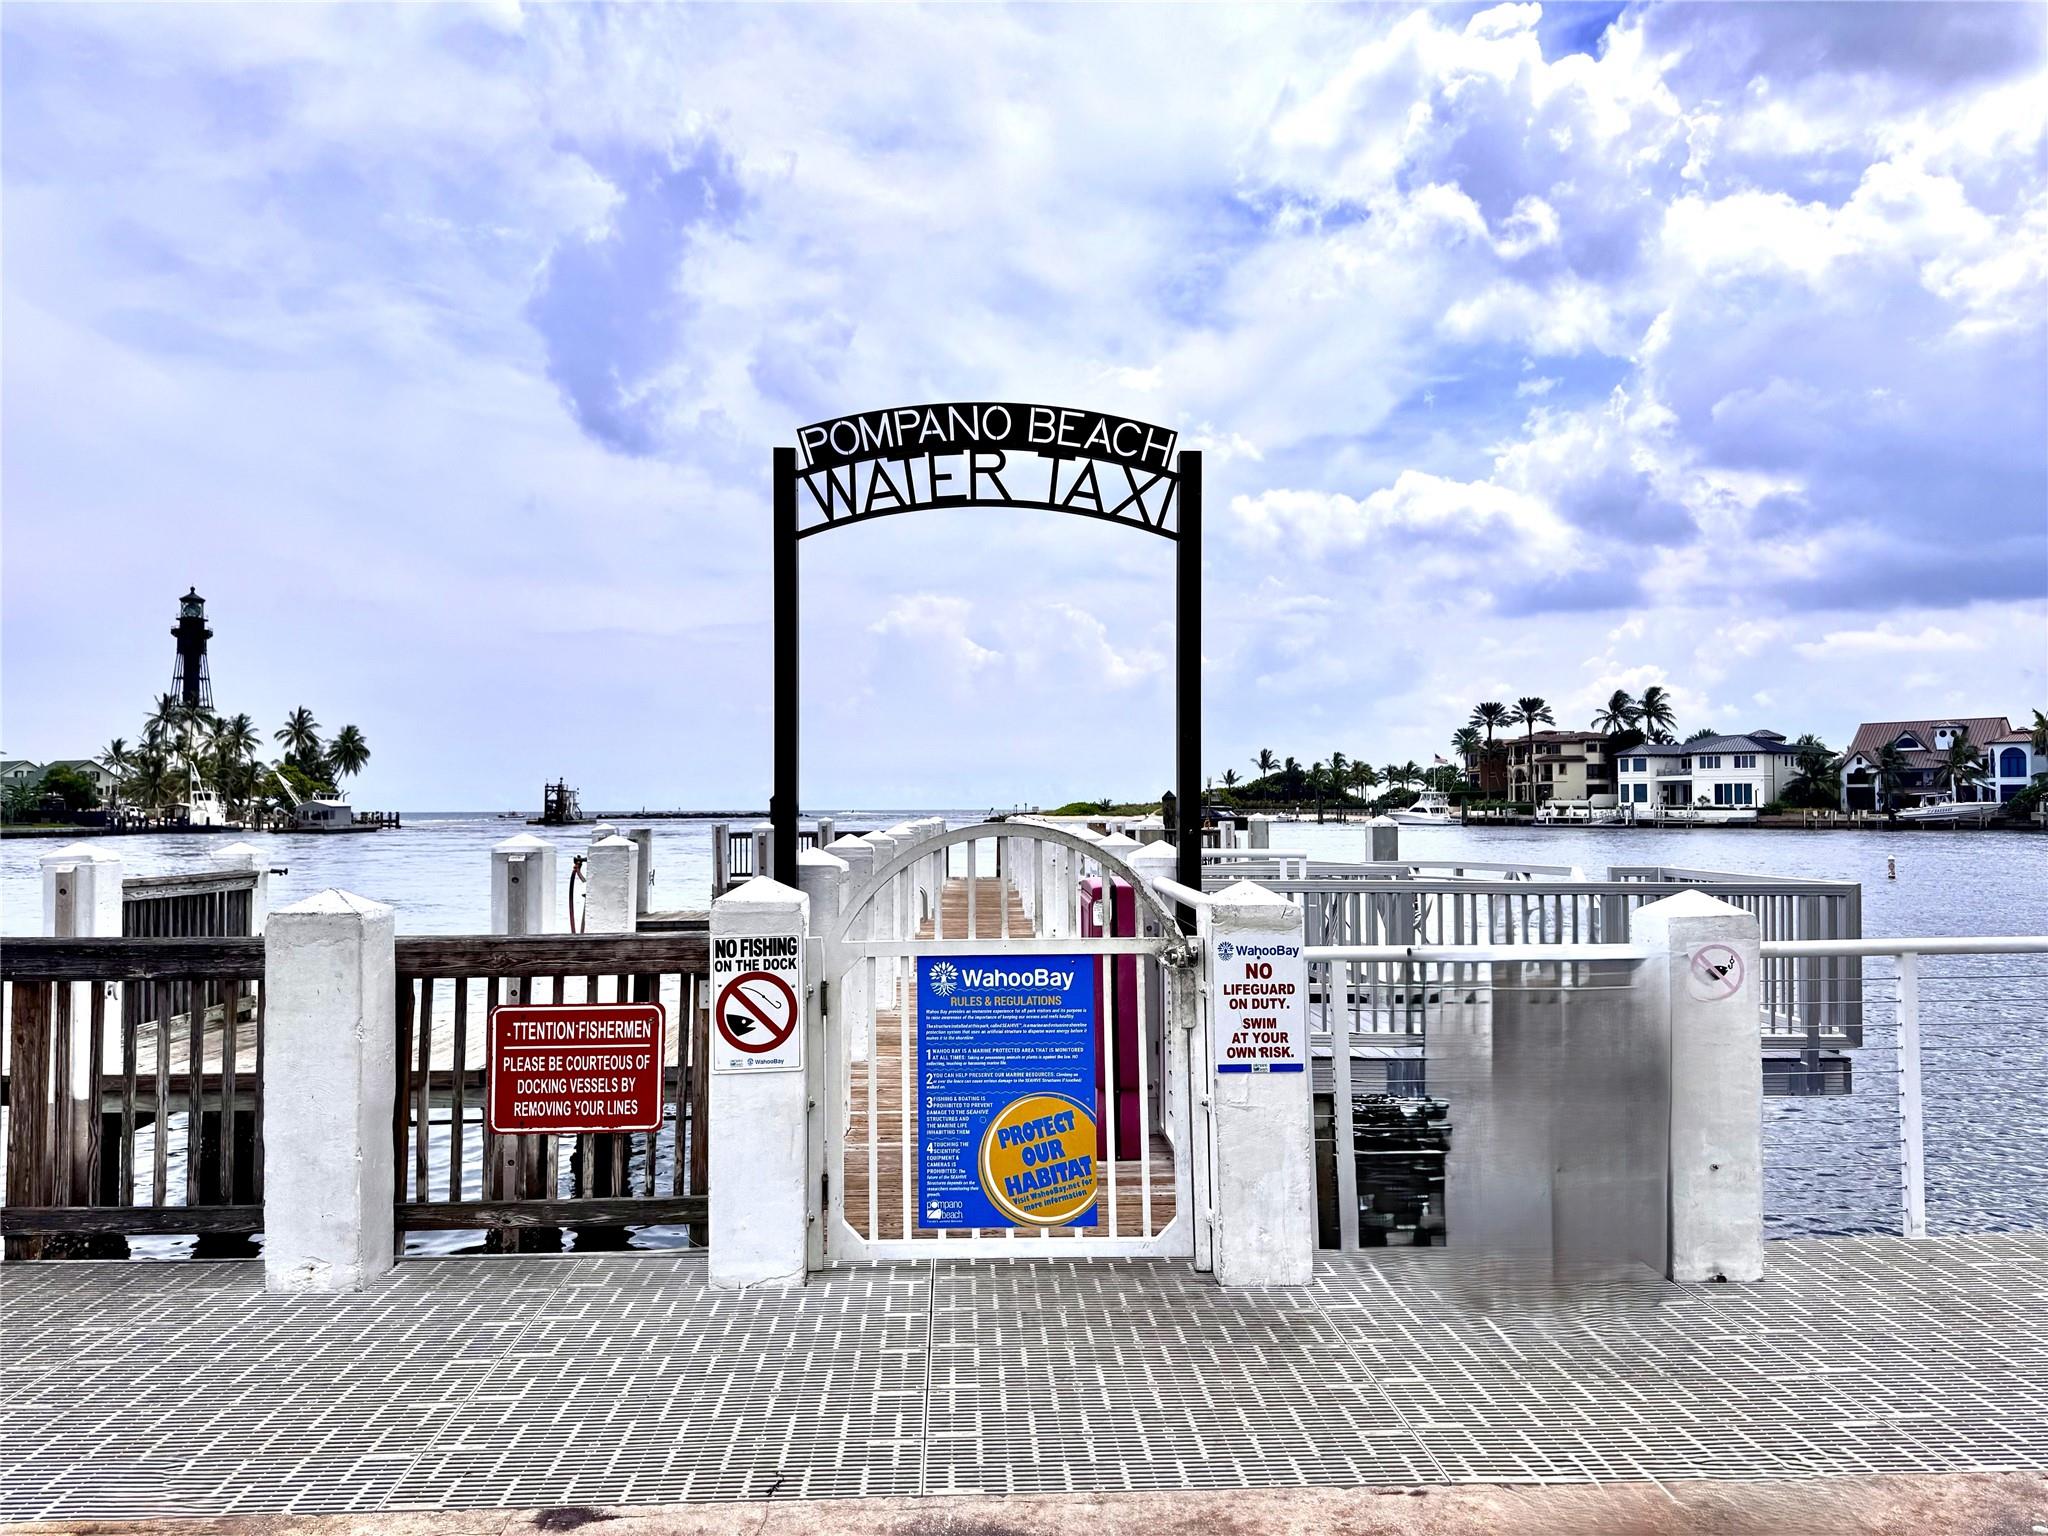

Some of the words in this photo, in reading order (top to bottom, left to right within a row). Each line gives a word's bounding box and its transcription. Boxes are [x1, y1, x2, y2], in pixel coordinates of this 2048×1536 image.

[800, 405, 1012, 465] POMPANO
[1028, 406, 1175, 467] BEACH
[802, 449, 1012, 521] WATER
[1038, 452, 1178, 528] TAXI
[715, 939, 737, 958] NO
[740, 937, 797, 957] FISHING
[1236, 945, 1299, 958] WahooBay
[715, 960, 732, 972] ON
[736, 959, 759, 971] THE
[763, 958, 797, 971] DOCK
[1245, 963, 1273, 979] NO
[961, 968, 1074, 990] WahooBay
[1223, 984, 1295, 995] LIFEGUARD
[950, 997, 982, 1007] RULES
[984, 997, 992, 1006] &
[994, 995, 1062, 1006] REGULATIONS
[1229, 998, 1248, 1009] ON
[1251, 998, 1290, 1009] DUTY.
[507, 1022, 575, 1040] TTENTION
[578, 1020, 651, 1039] FISHERMEN
[1242, 1018, 1277, 1029] SWIM
[1231, 1032, 1248, 1044] AT
[1252, 1032, 1289, 1044] YOUR
[926, 1049, 931, 1060] 1
[1226, 1047, 1256, 1059] OWN
[1259, 1046, 1294, 1058] RISK.
[503, 1056, 545, 1072] PLEASE
[548, 1056, 563, 1071] BE
[566, 1055, 633, 1071] COURTEOUS
[636, 1054, 650, 1070] OF
[517, 1078, 567, 1094] DOCKING
[569, 1077, 618, 1093] VESSELS
[621, 1077, 636, 1092] BY
[926, 1073, 933, 1085] 2
[514, 1101, 571, 1117] REMOVING
[574, 1100, 604, 1116] YOUR
[607, 1099, 638, 1115] LINES
[926, 1097, 933, 1108] 3
[997, 1110, 1075, 1149] PROTECT
[926, 1142, 933, 1154] 4
[1021, 1139, 1066, 1167] OUR
[1004, 1155, 1092, 1197] HABITAT
[1013, 1195, 1030, 1204] Visit
[1030, 1182, 1080, 1200] WahooBay.net
[1082, 1178, 1093, 1187] for
[926, 1200, 963, 1210] pompano
[1023, 1201, 1042, 1212] more
[1044, 1189, 1087, 1206] information
[941, 1210, 964, 1219] beach
